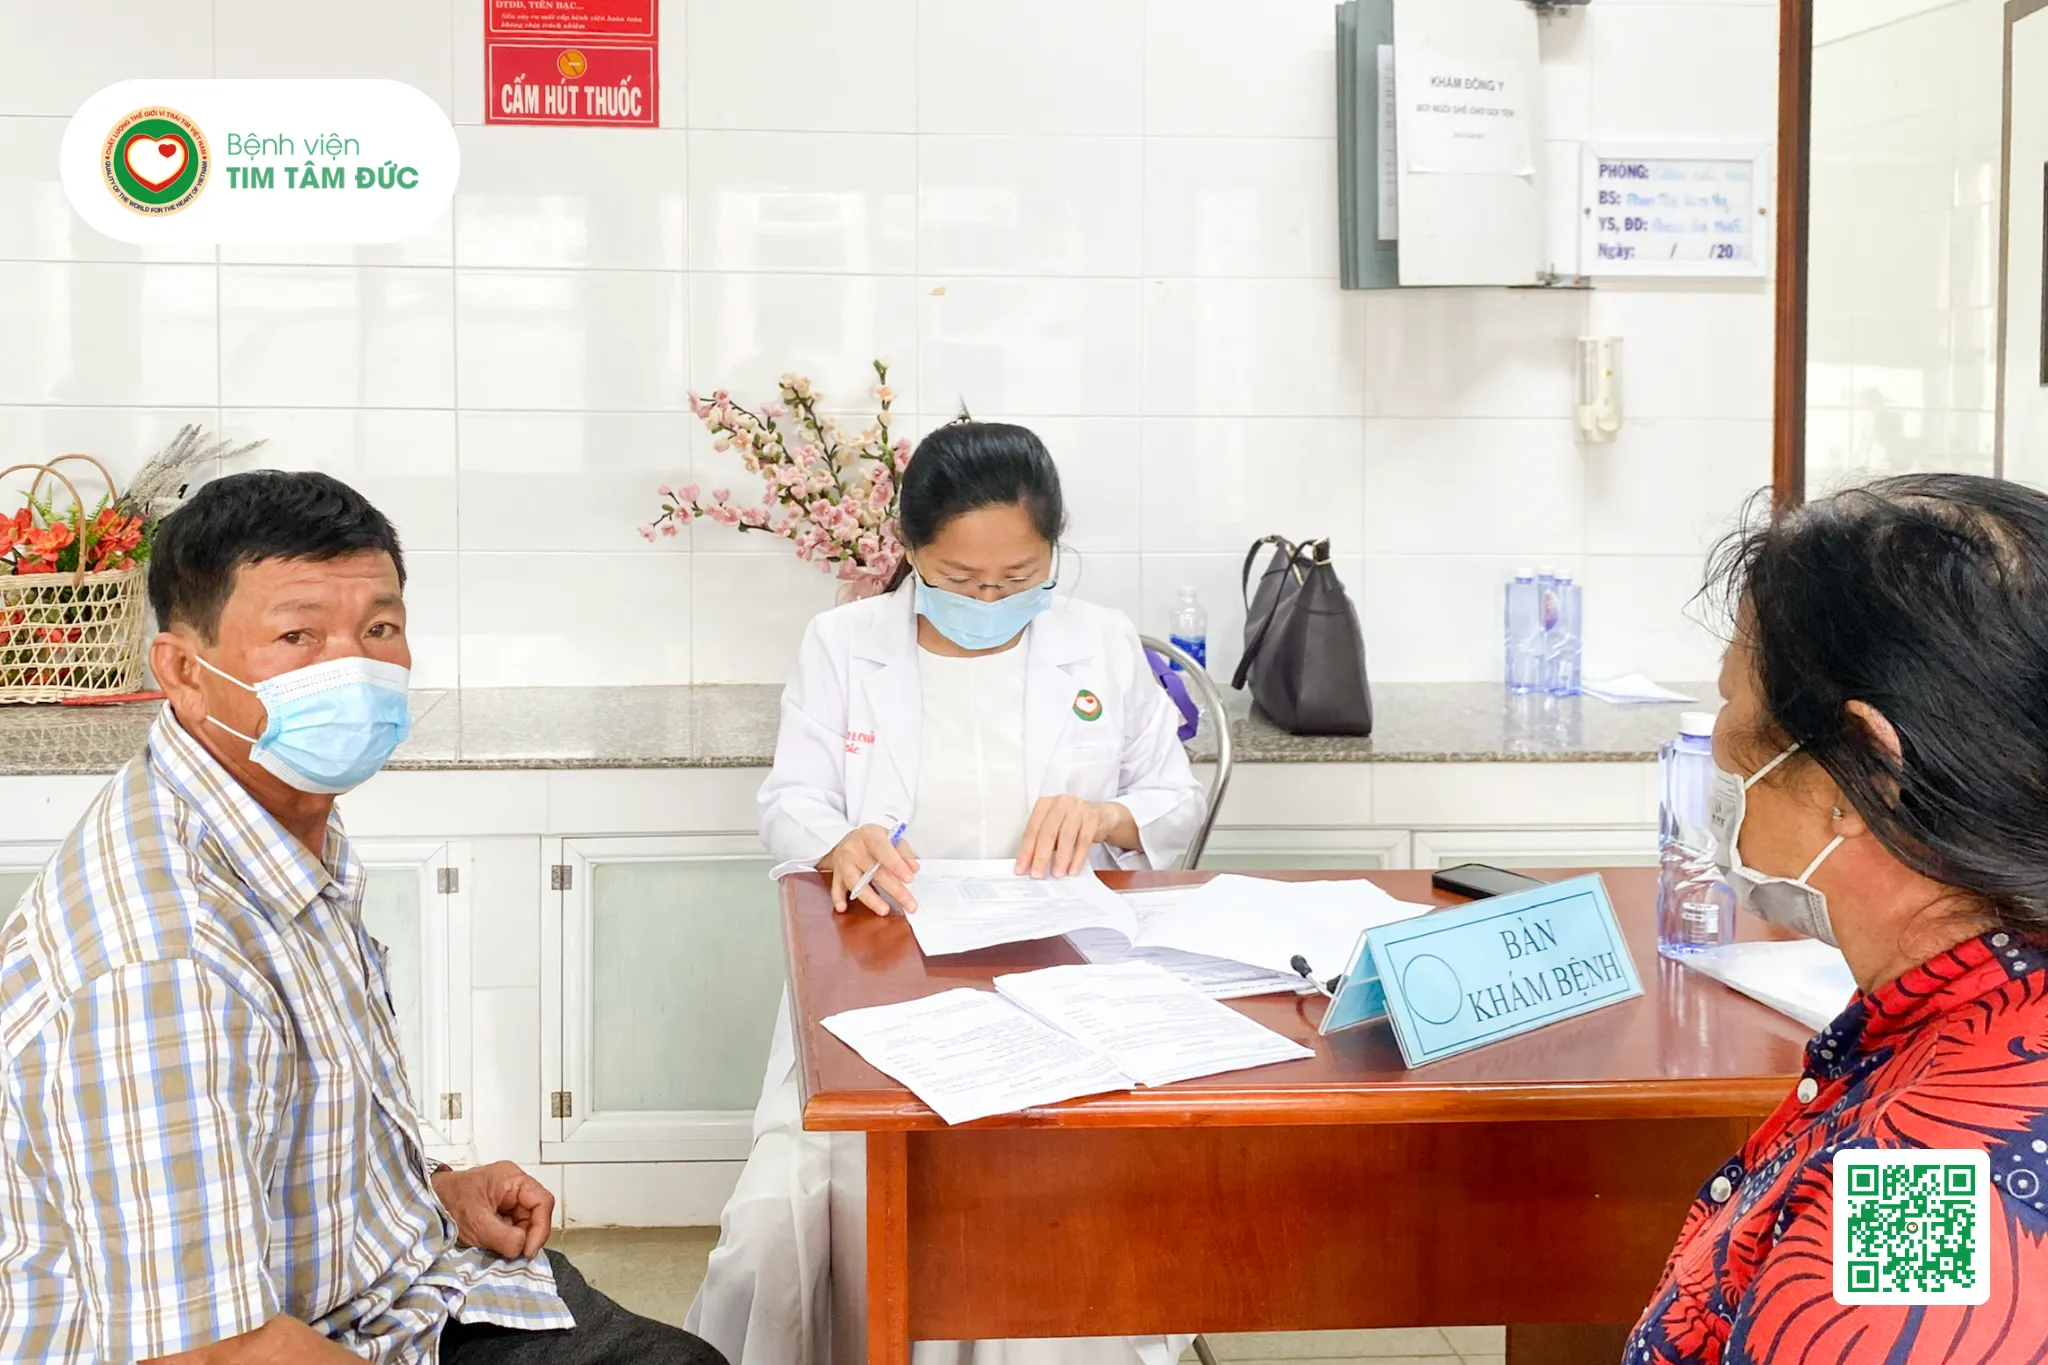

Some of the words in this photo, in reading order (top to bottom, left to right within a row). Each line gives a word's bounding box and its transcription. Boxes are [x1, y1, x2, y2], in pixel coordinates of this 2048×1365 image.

[501, 73, 540, 114] CẤM
[545, 78, 579, 115] HÚT
[584, 75, 642, 117] THUỐC
[1598, 190, 1621, 205] BS:
[1598, 242, 1635, 260] Ngày:
[1499, 917, 1558, 960] BÀN
[1466, 970, 1553, 1023] KHÁM
[1550, 951, 1622, 997] BỆNH
